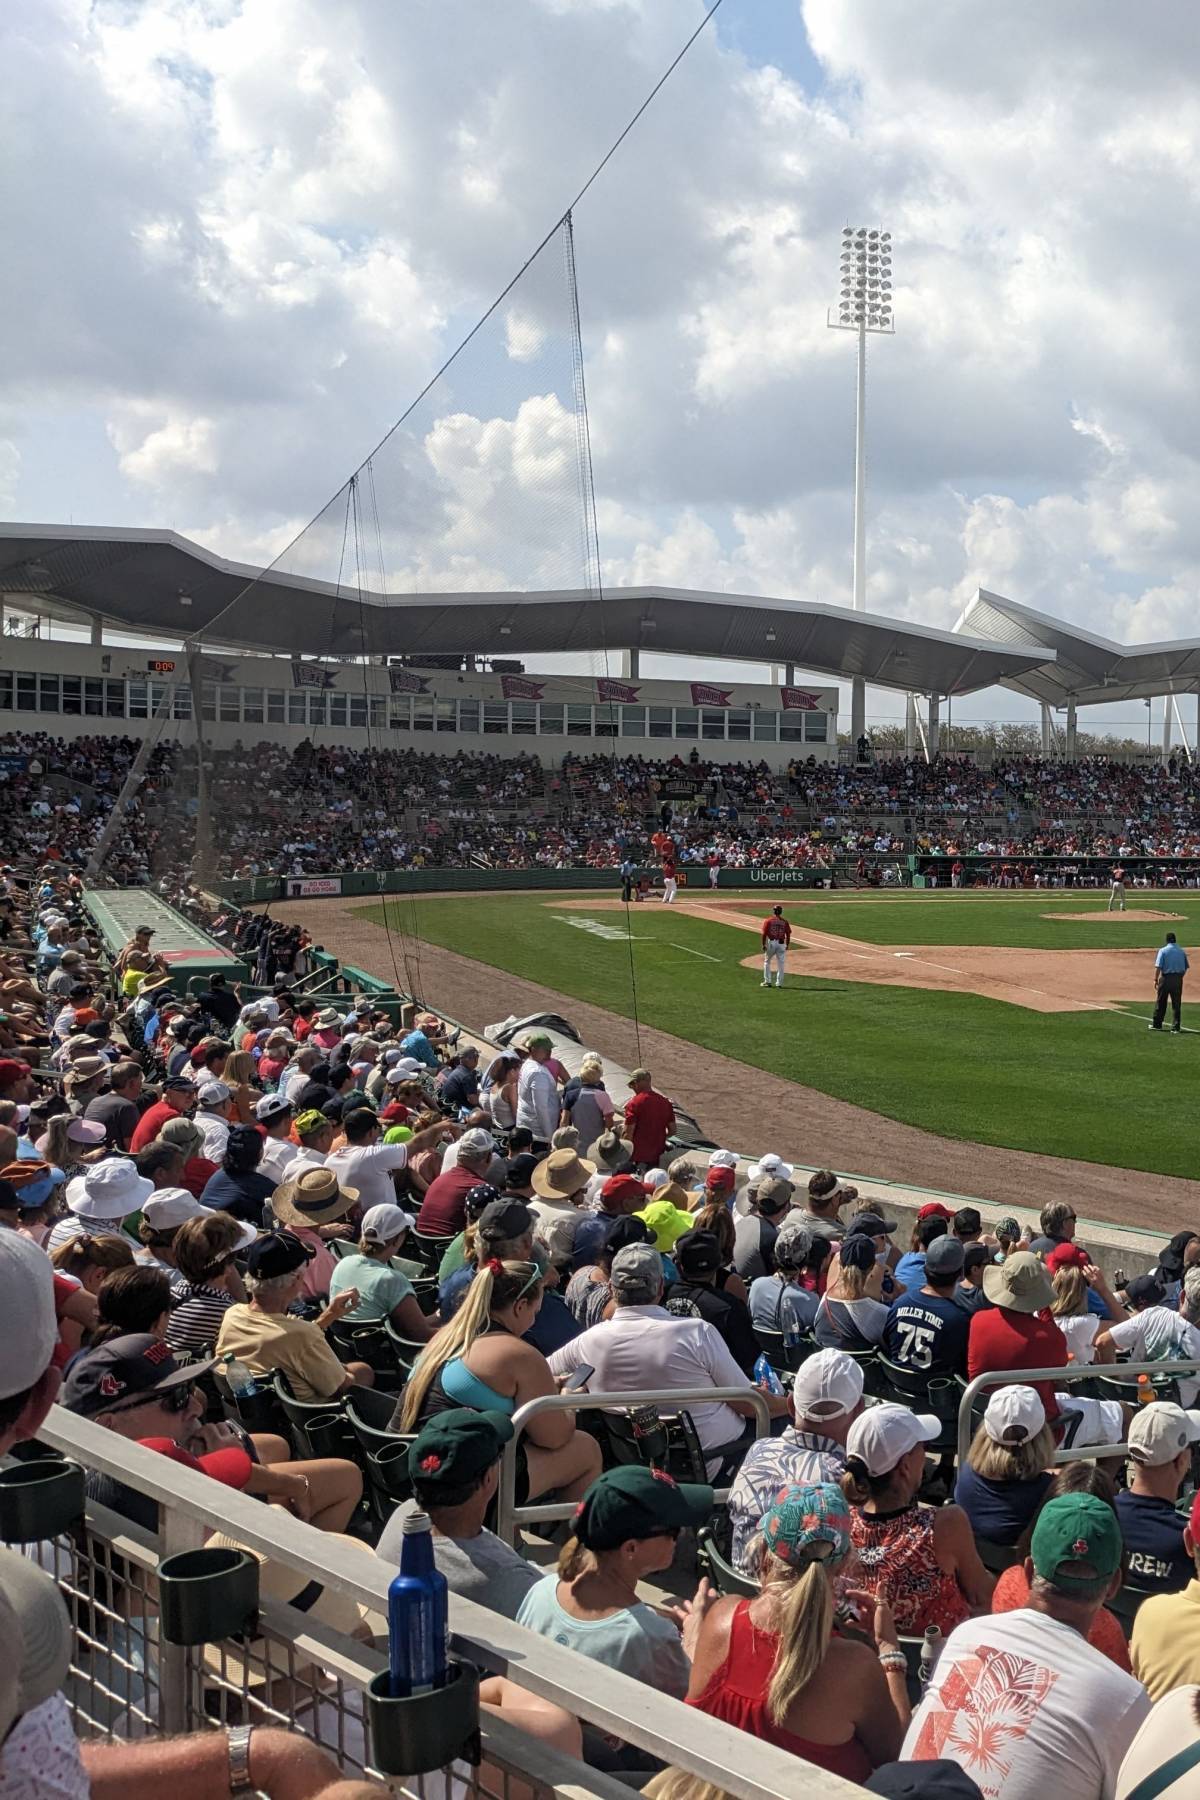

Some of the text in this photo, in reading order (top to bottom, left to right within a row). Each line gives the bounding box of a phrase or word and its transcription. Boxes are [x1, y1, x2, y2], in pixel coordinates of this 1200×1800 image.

[897, 1306, 944, 1330] MILLER TIME
[897, 1321, 935, 1370] 75
[1127, 1552, 1174, 1577] REW
